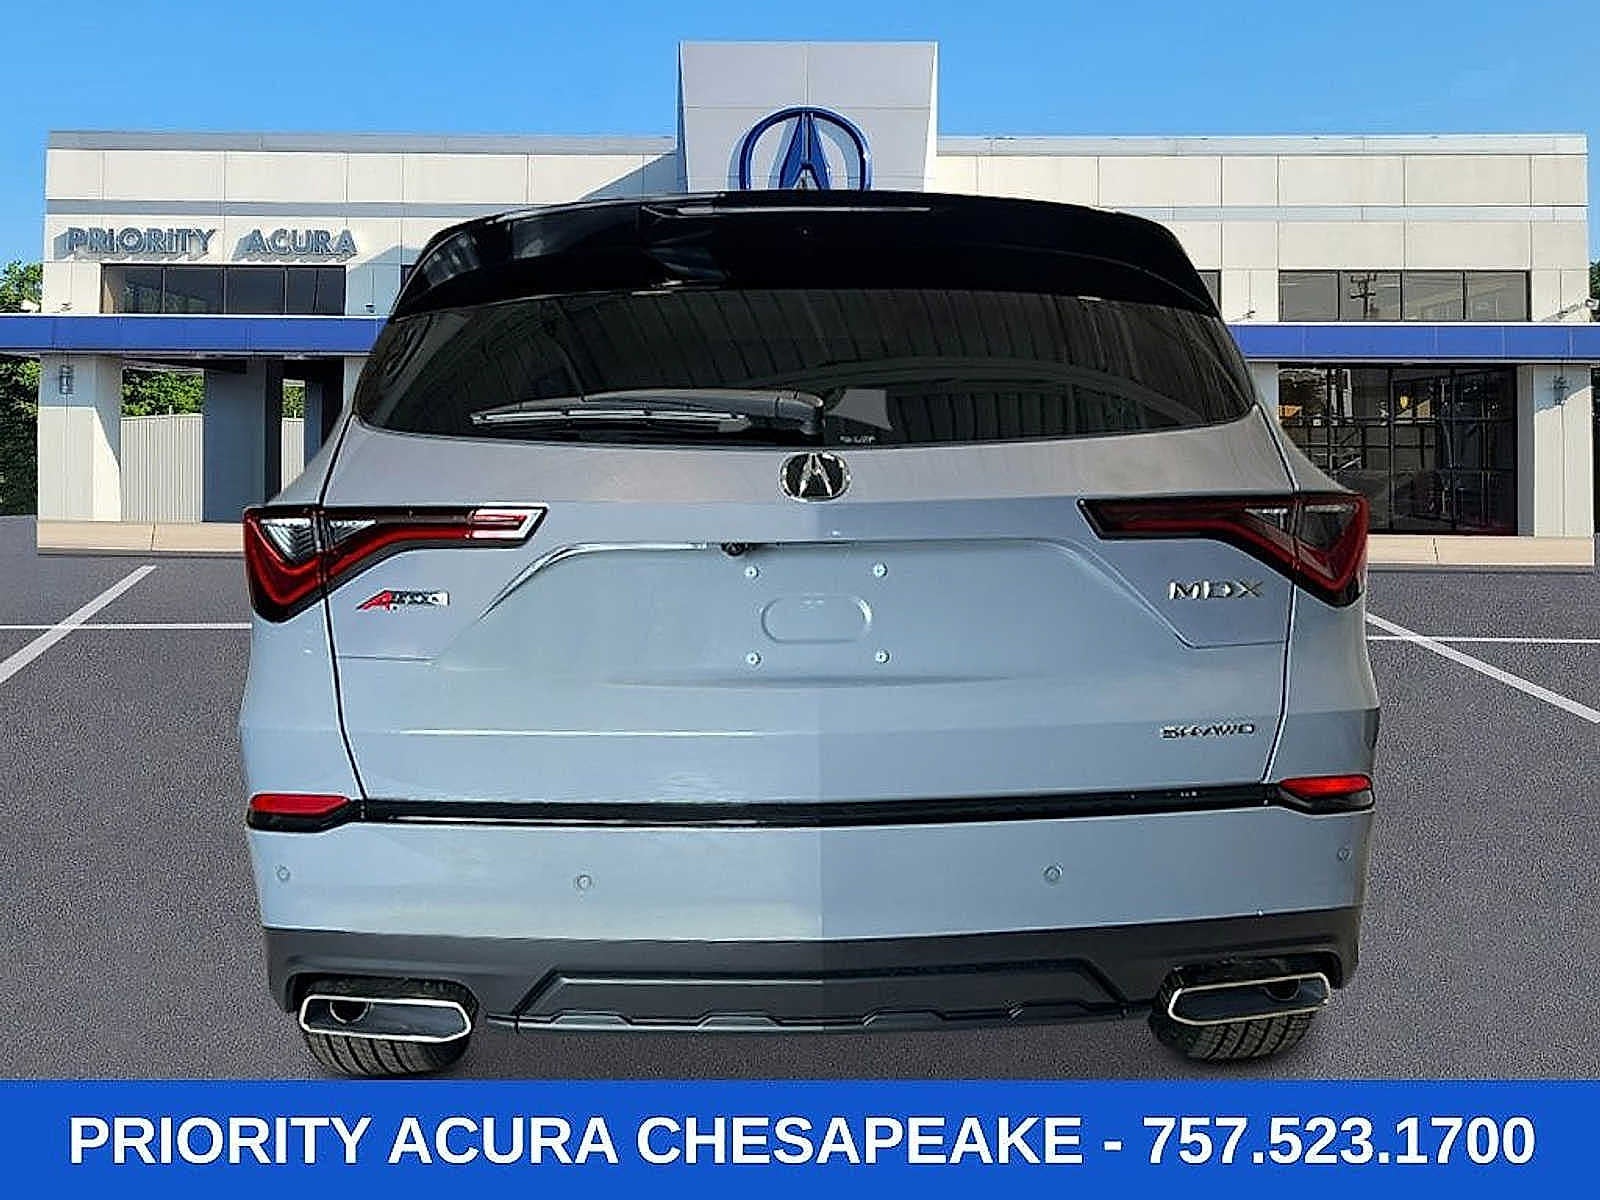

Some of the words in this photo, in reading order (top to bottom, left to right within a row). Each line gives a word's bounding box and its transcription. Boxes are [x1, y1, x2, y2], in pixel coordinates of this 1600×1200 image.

[66, 227, 215, 255] PRIORITY
[247, 228, 357, 256] ACURA
[1168, 580, 1263, 600] MDX
